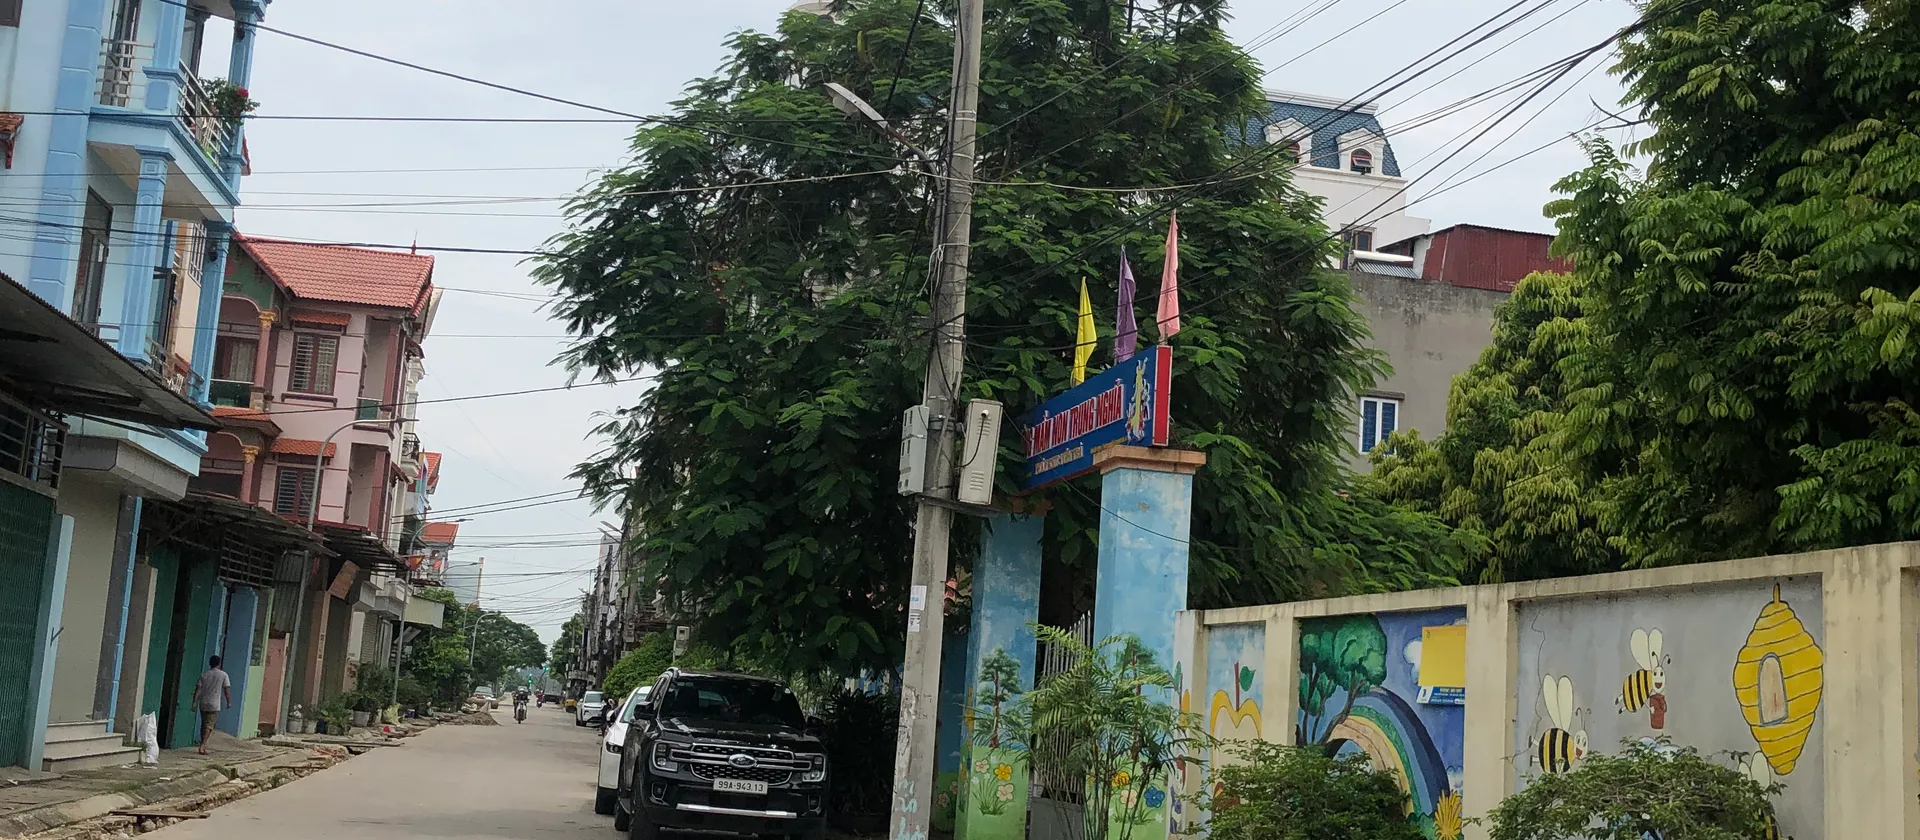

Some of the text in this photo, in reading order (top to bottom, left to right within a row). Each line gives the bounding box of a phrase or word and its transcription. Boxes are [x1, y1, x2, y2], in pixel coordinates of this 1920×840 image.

[1053, 409, 1071, 447] NON
[1069, 396, 1097, 441] TRUNG
[1096, 378, 1124, 429] NGHĨA
[718, 780, 764, 792] 99A-943.13
